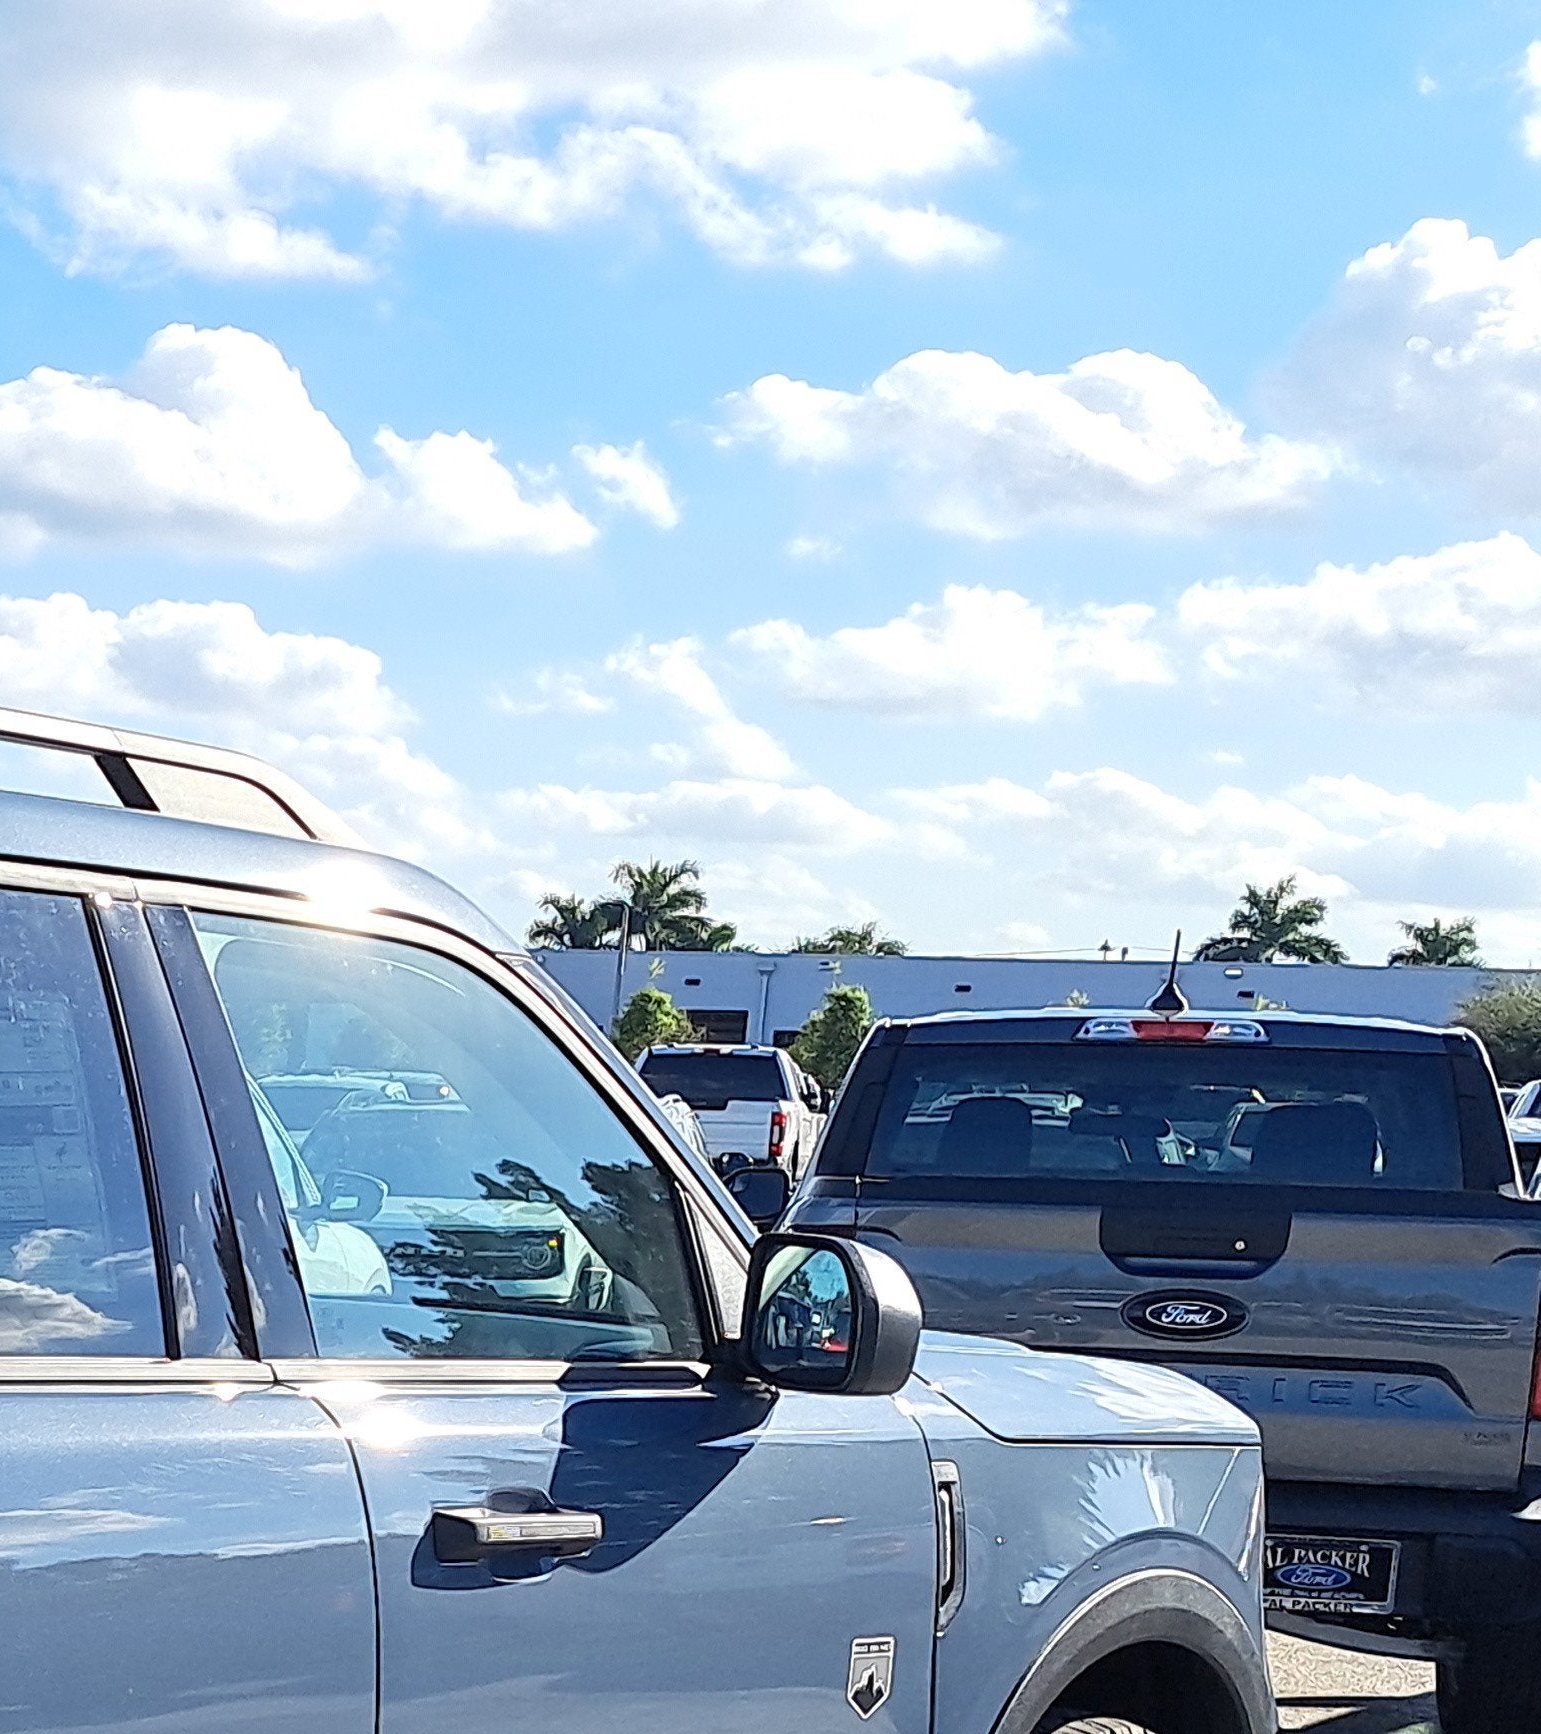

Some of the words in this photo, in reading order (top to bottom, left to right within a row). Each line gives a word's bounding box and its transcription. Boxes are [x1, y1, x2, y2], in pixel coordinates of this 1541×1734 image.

[1161, 1302, 1213, 1326] Ford
[1292, 1548, 1370, 1577] PACKER
[1290, 1564, 1337, 1586] Ford
